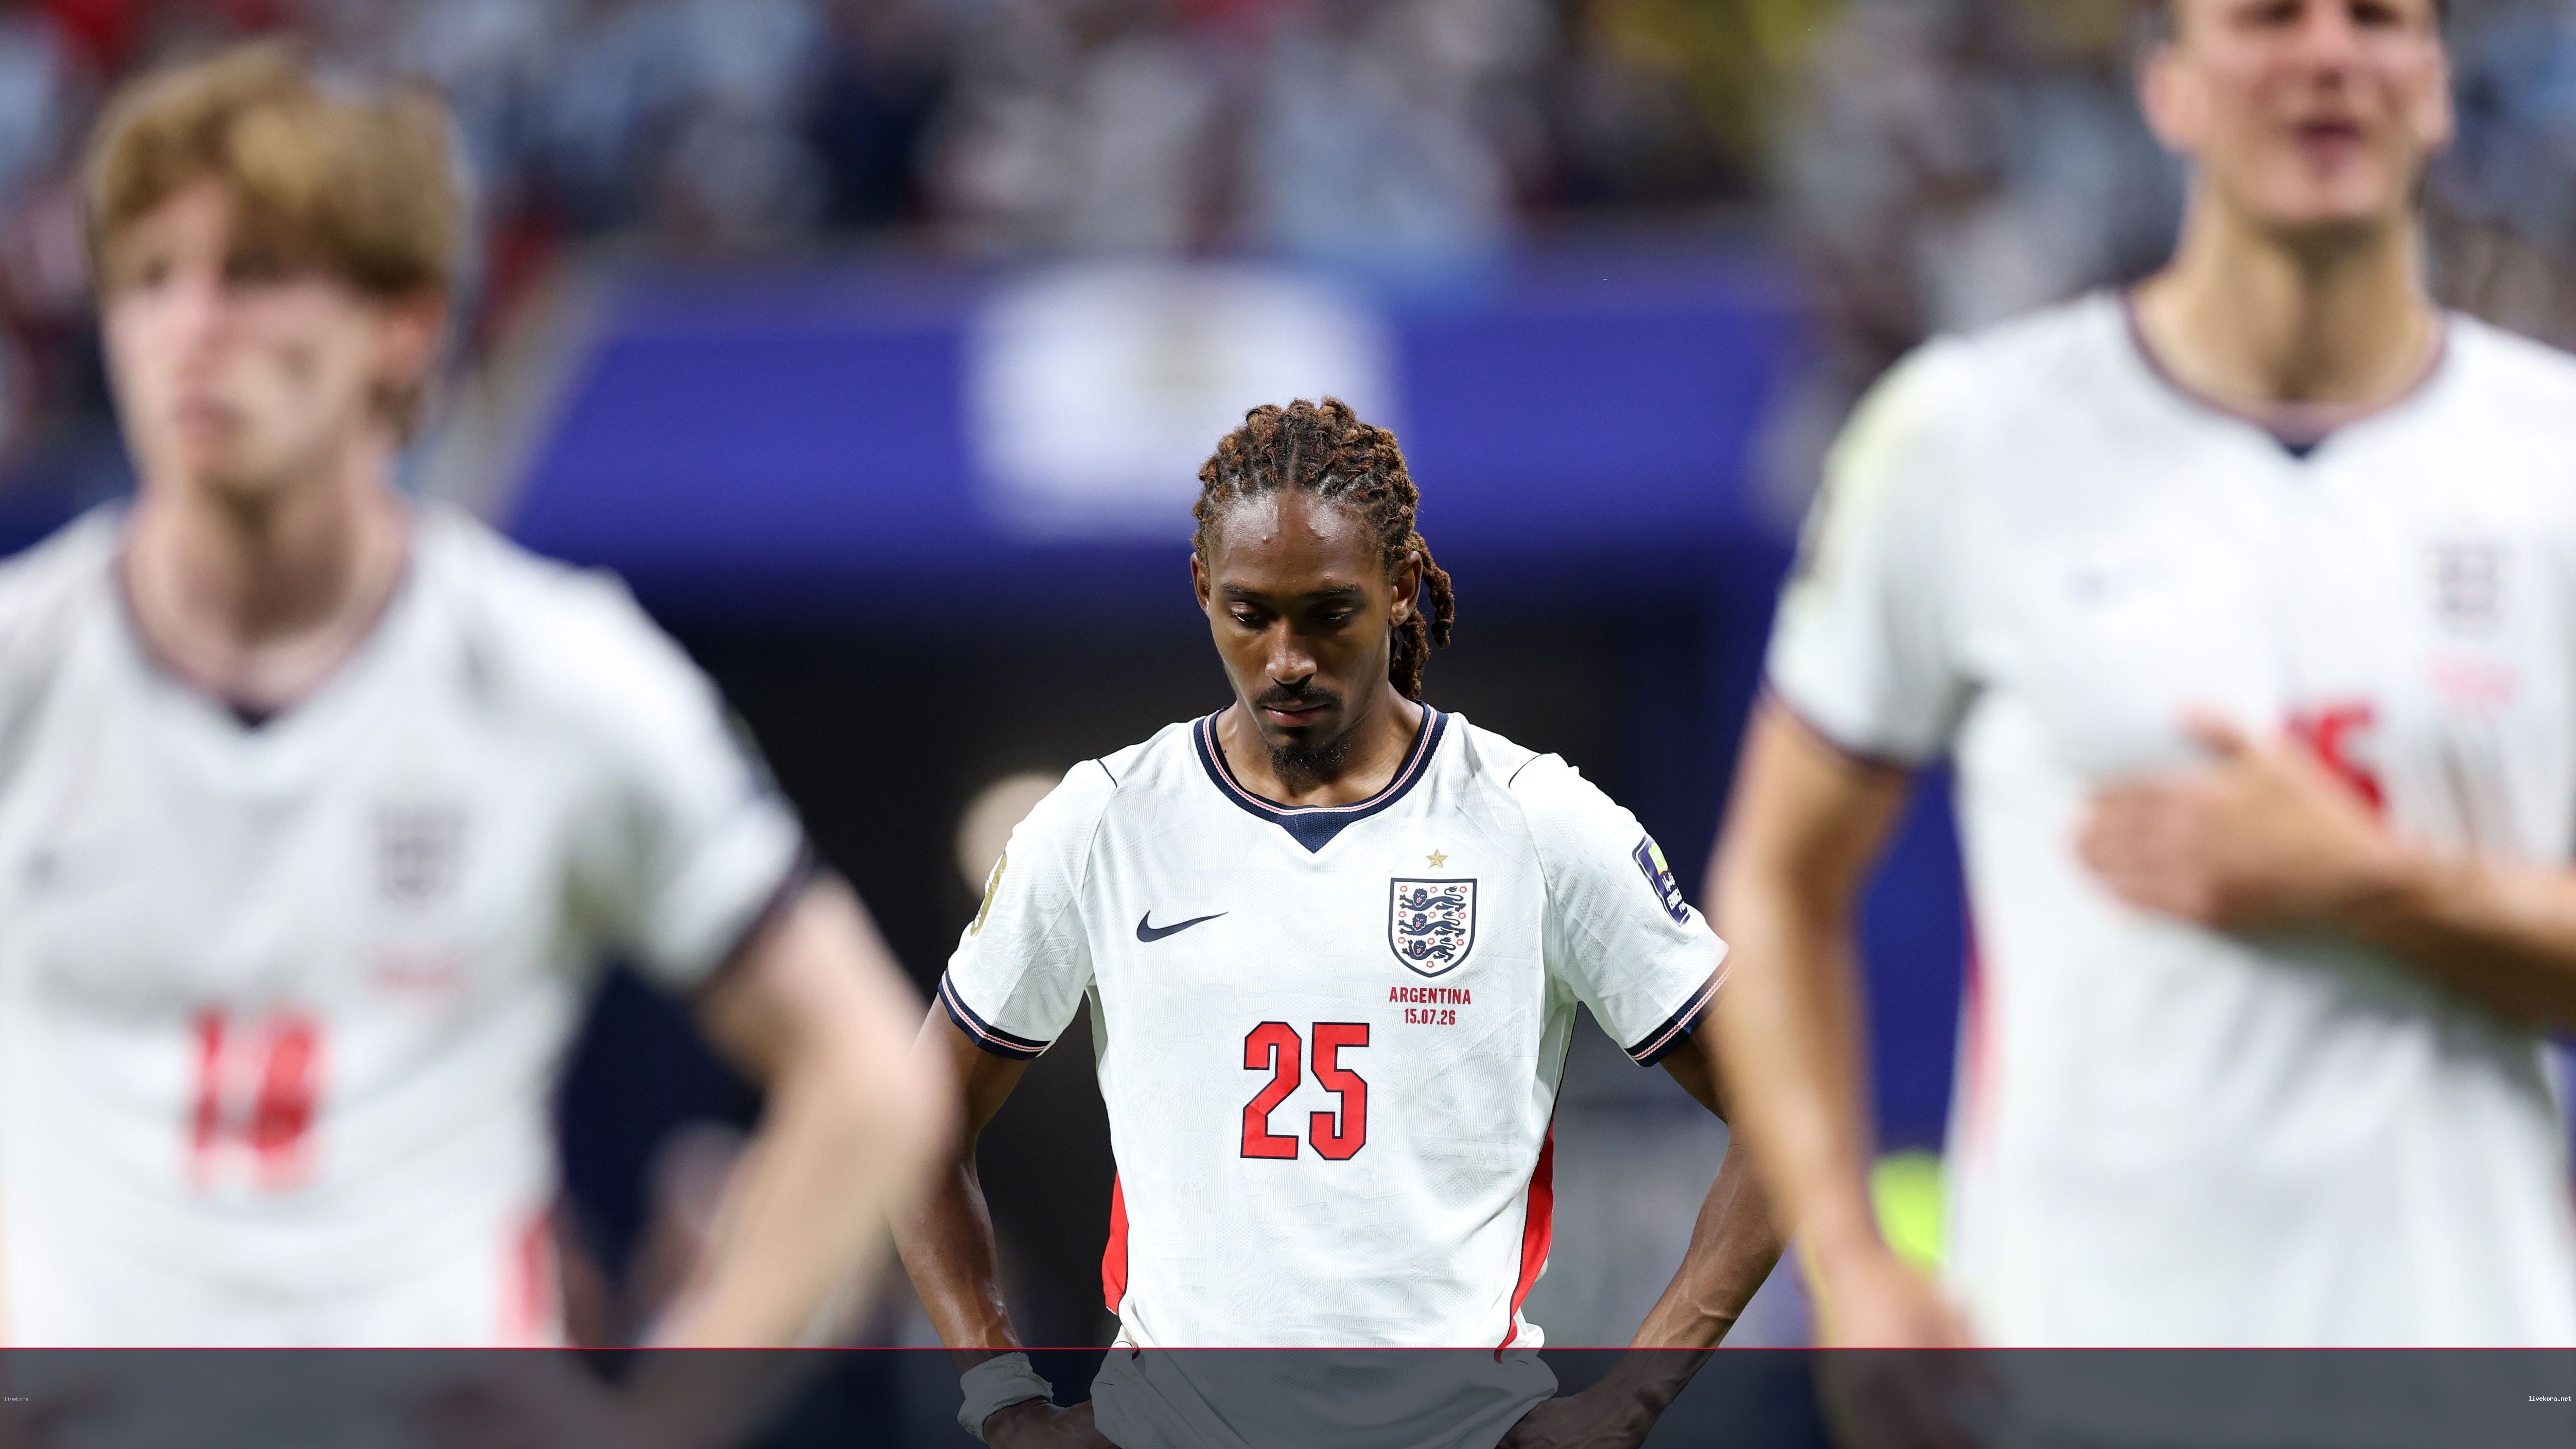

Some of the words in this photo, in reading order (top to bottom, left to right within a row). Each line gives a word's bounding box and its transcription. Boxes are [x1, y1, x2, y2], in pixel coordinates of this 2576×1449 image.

[1389, 986, 1471, 1005] ARGENTINA
[1404, 1008, 1456, 1025] 15.07.26
[1240, 1021, 1370, 1161] 25
